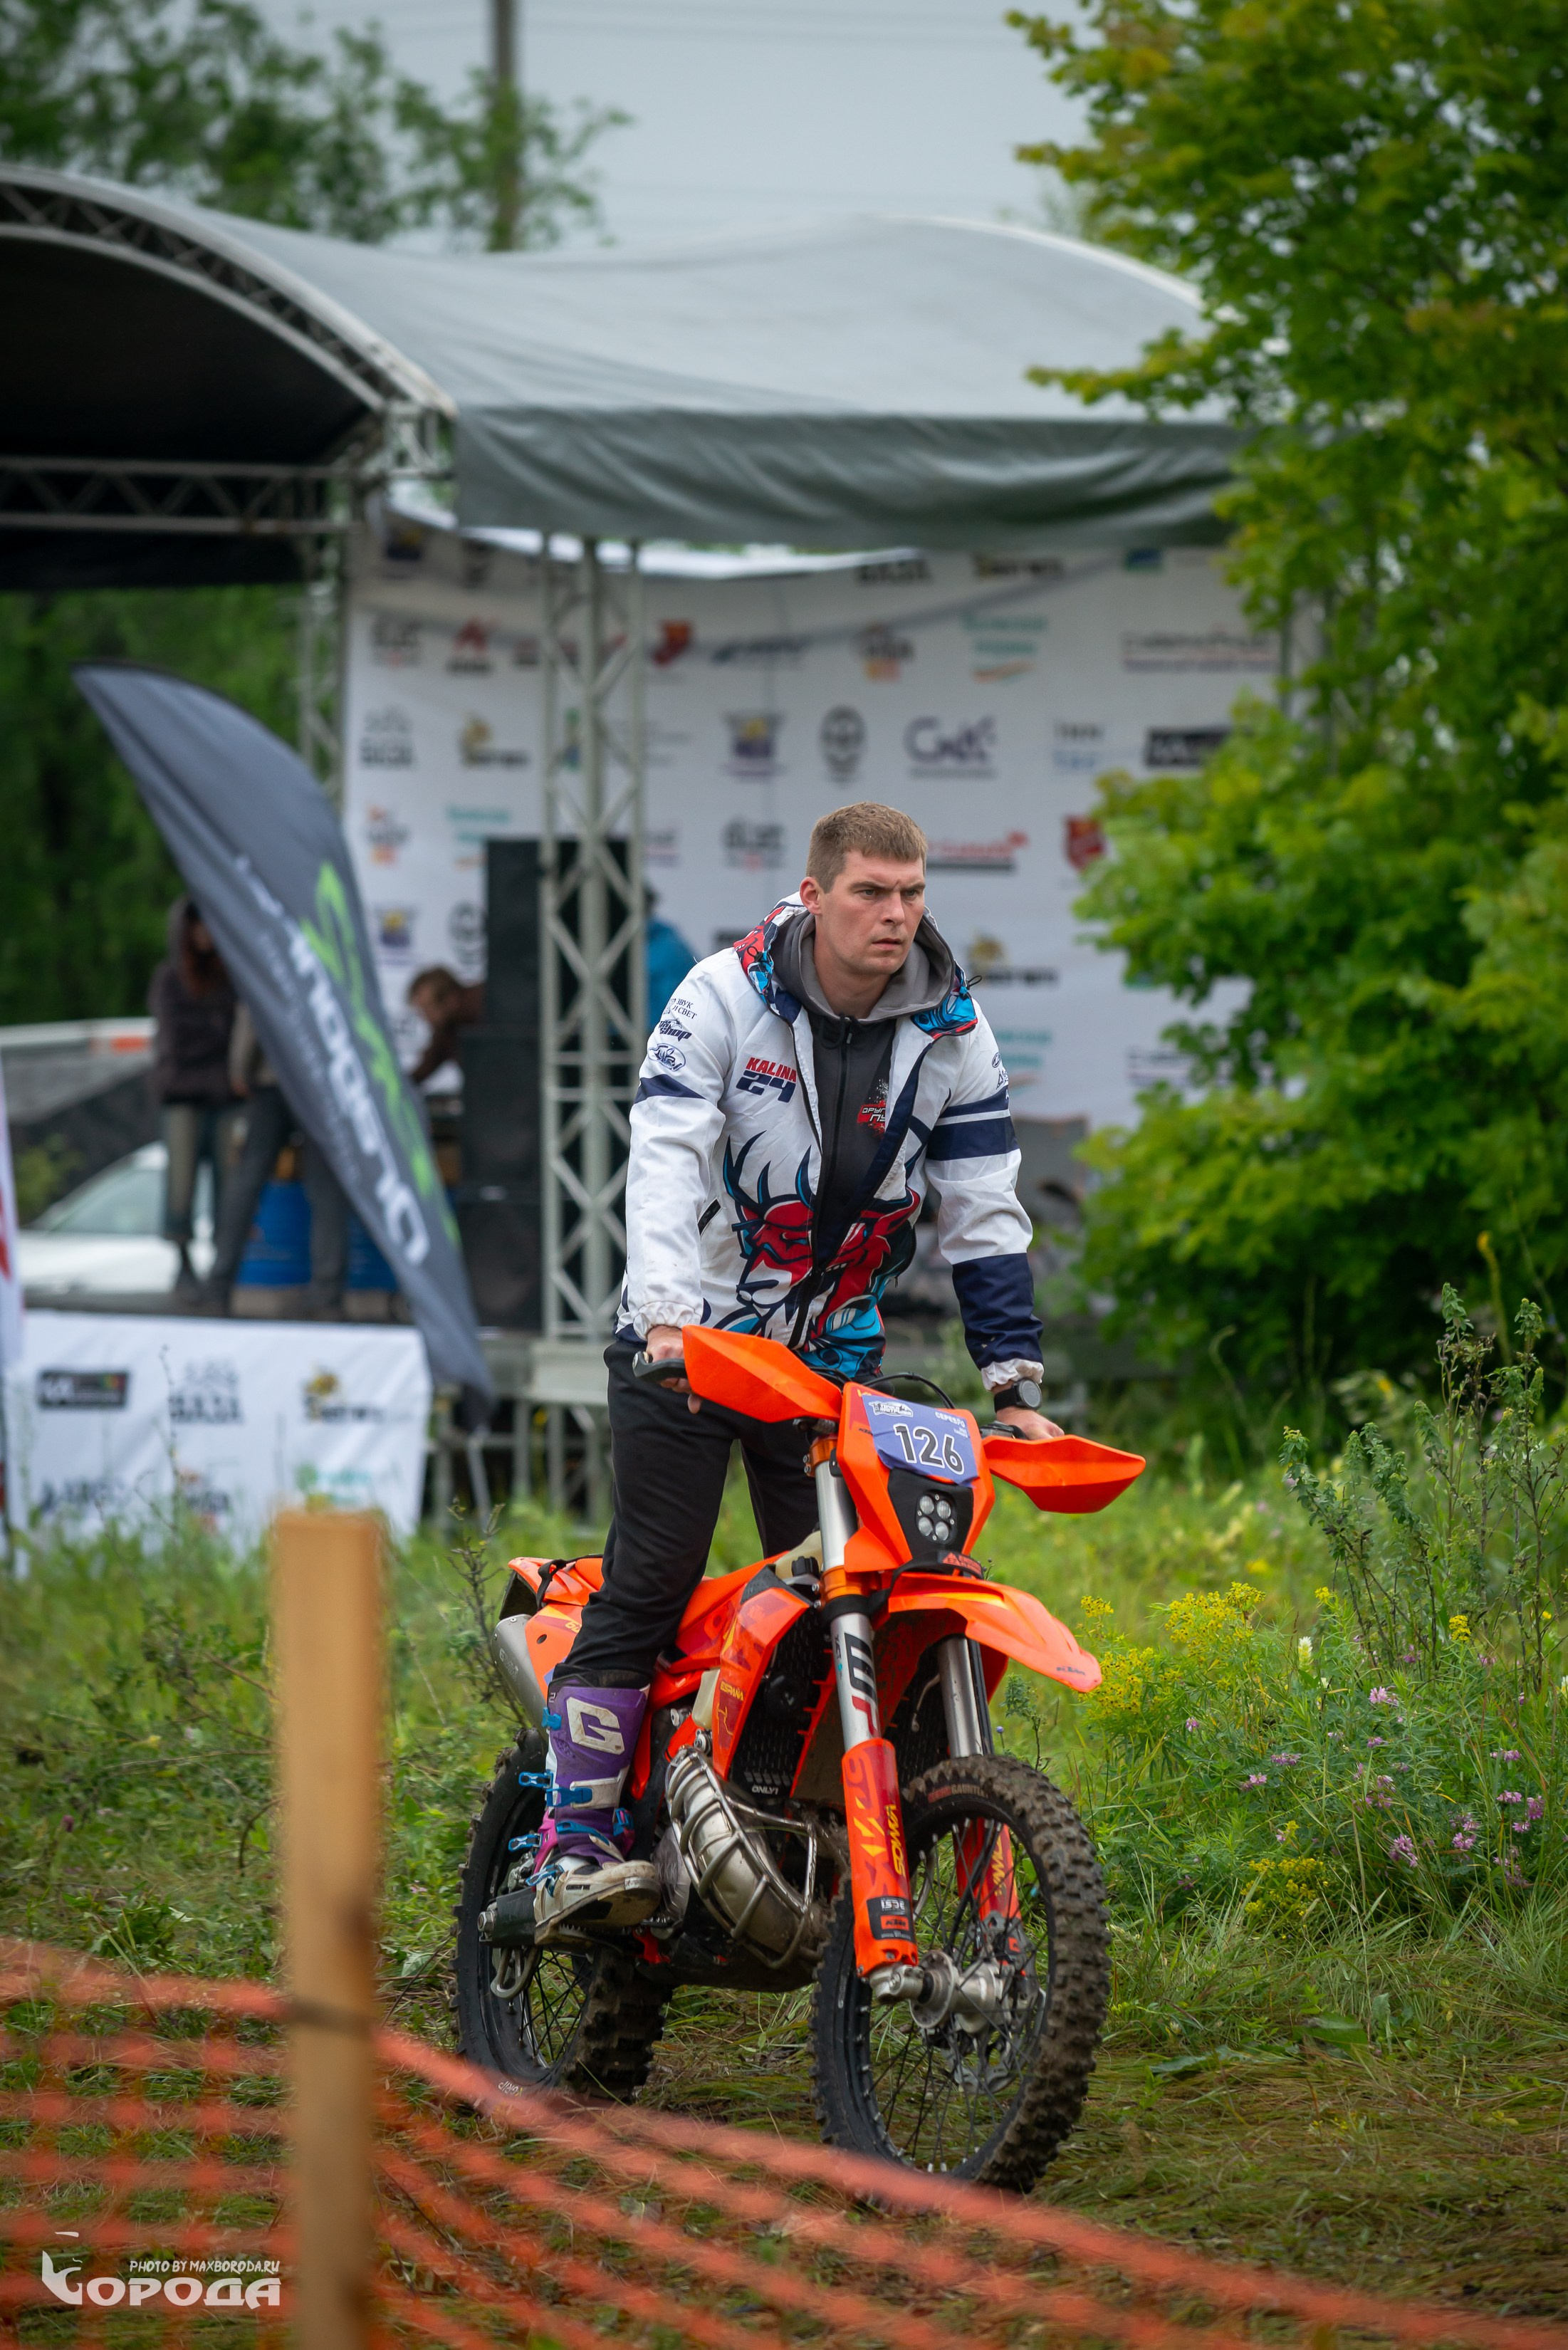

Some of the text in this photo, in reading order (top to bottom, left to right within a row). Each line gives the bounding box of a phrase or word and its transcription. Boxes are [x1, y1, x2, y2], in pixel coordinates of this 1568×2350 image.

[676, 998, 693, 1009] ЗВУК
[678, 1007, 697, 1020] СВЕТ
[745, 1057, 797, 1083] KALINA
[736, 1070, 797, 1103] 24
[893, 1423, 965, 1476] 126
[885, 1804, 906, 1879] VAMOS
